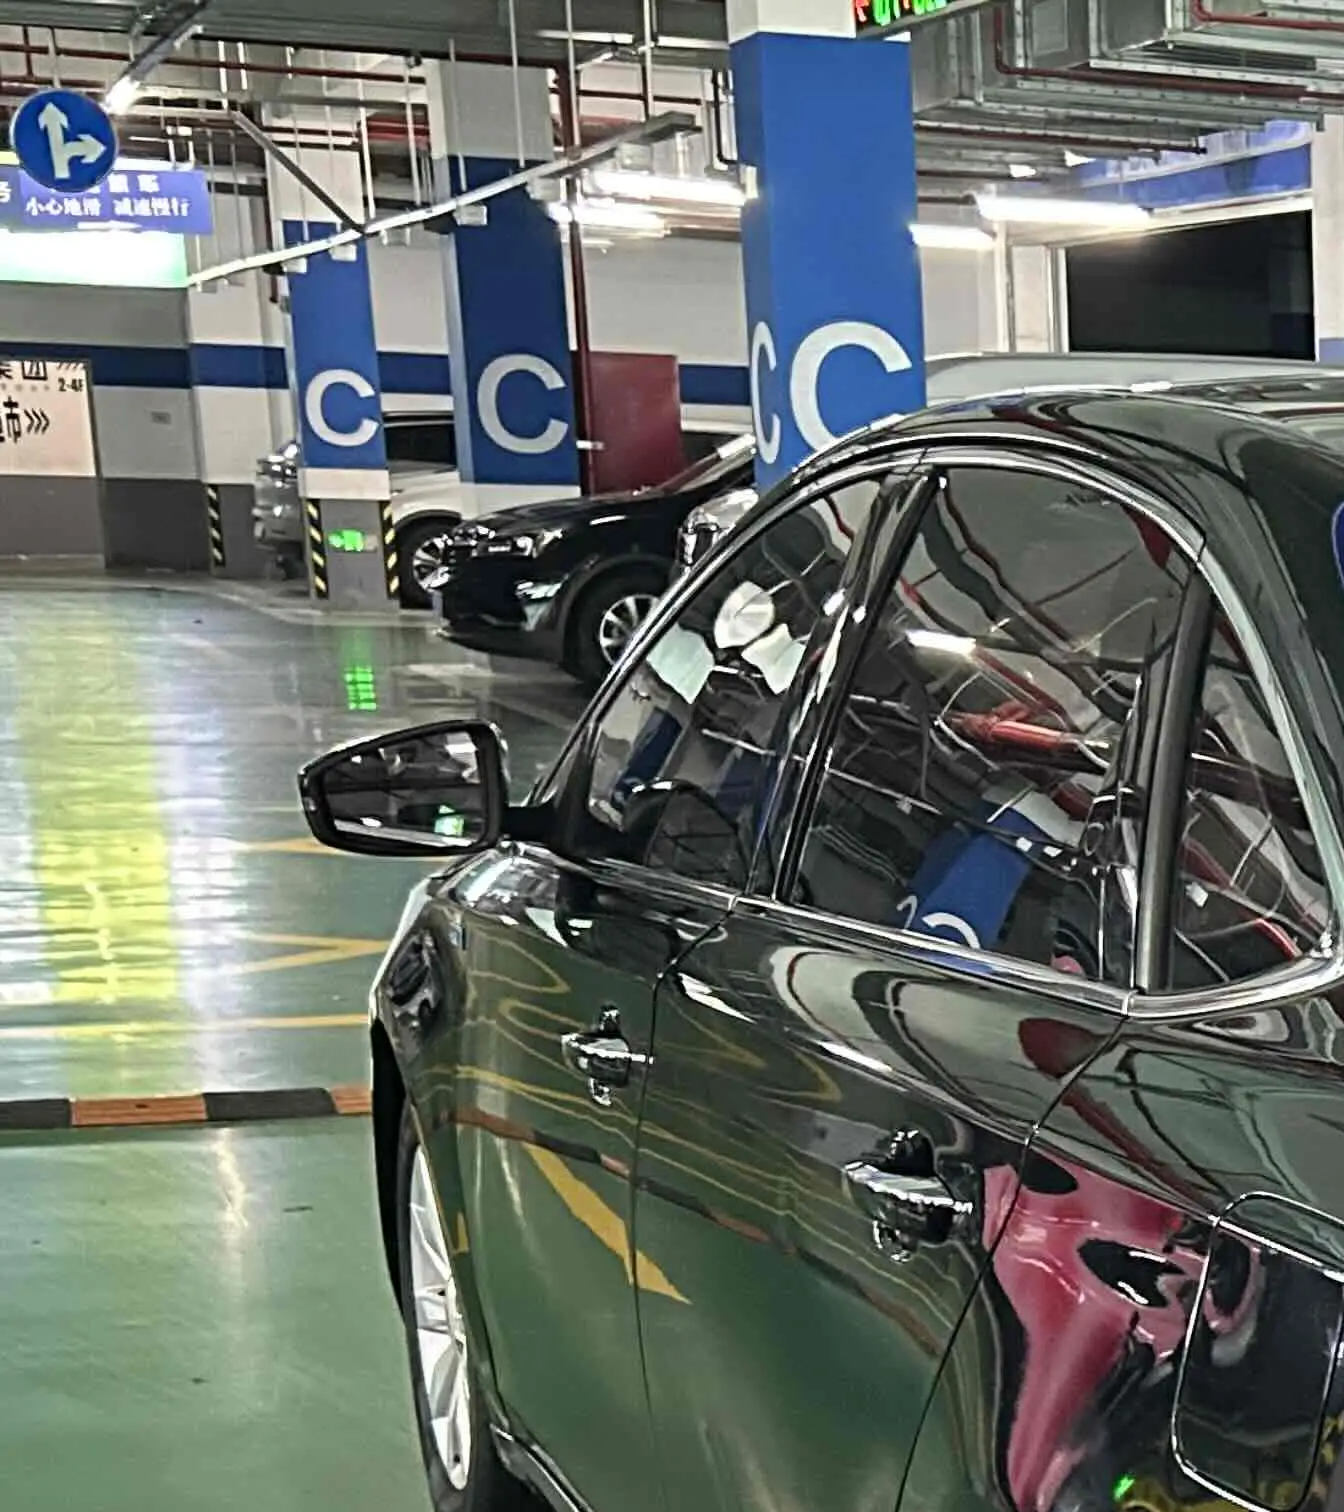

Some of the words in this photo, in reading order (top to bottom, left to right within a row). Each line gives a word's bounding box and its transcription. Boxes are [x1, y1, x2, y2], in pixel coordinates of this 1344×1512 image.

[305, 369, 380, 447] C
[477, 353, 569, 454] C
[751, 321, 781, 464] C
[791, 320, 912, 452] C
